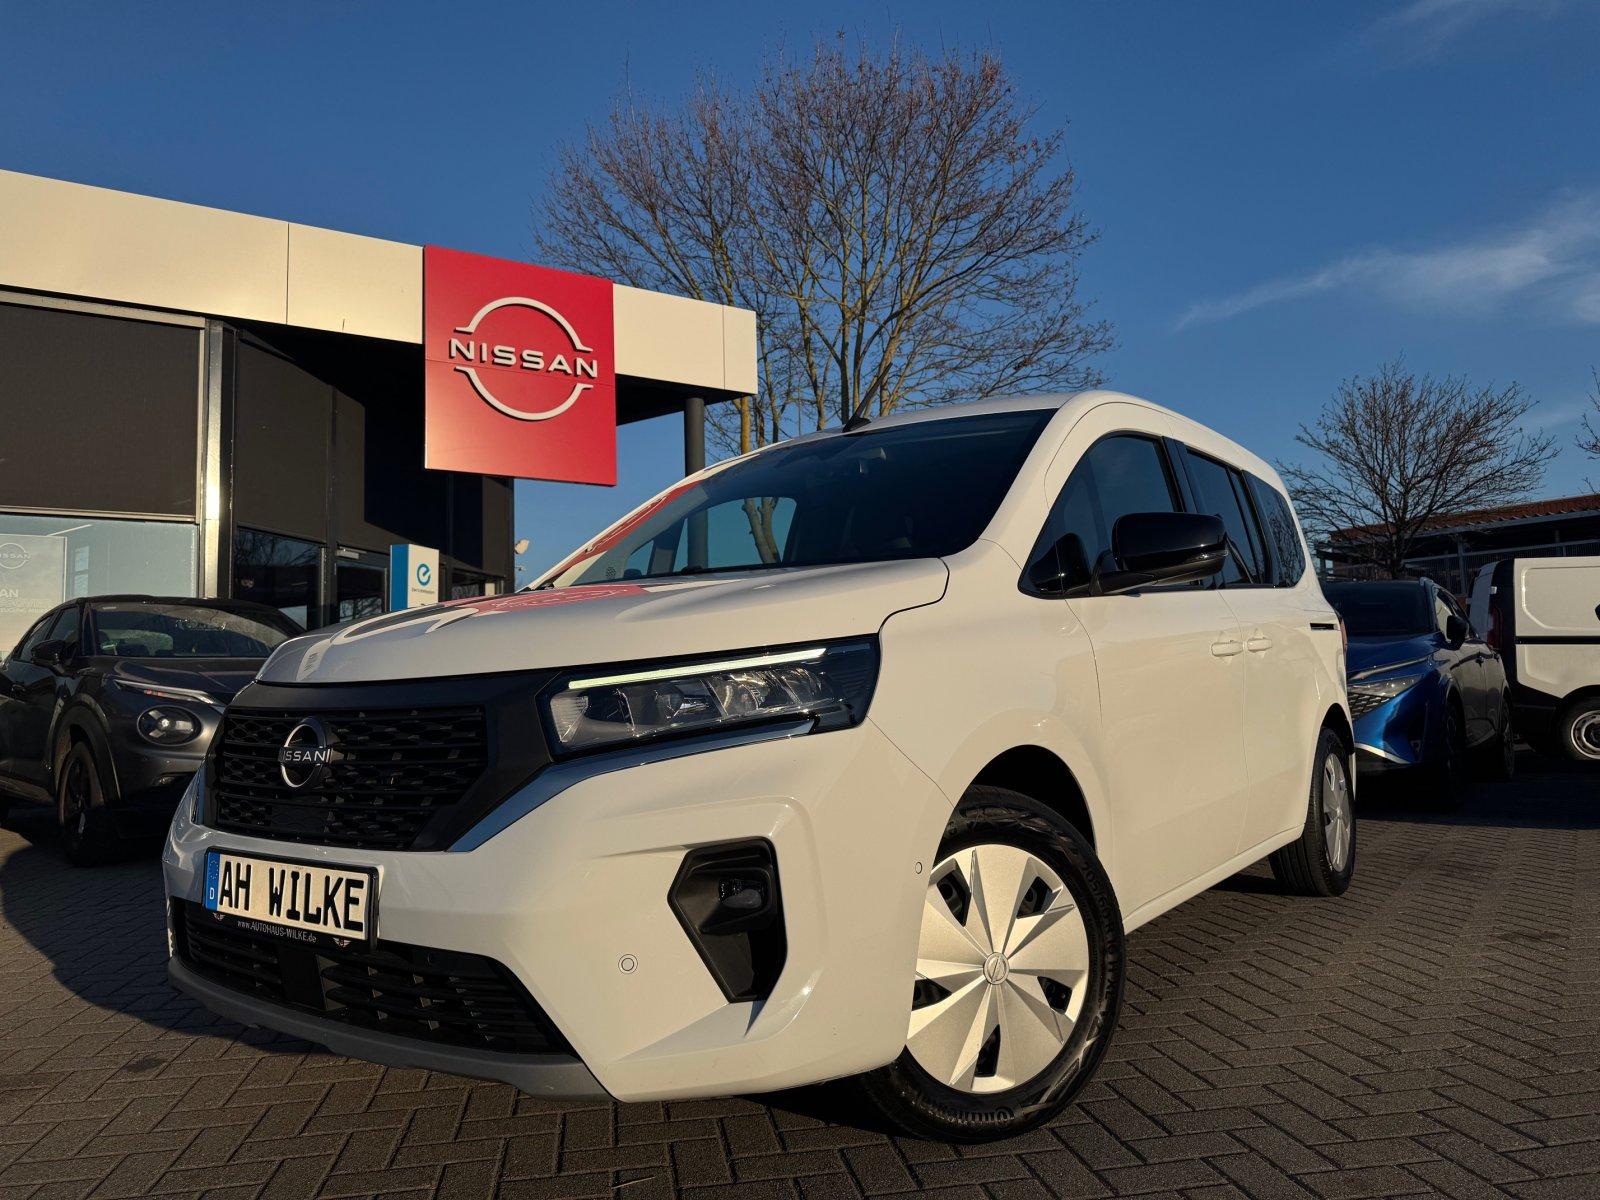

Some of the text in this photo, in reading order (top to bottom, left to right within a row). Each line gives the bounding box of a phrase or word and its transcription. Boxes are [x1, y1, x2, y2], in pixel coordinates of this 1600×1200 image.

[449, 338, 598, 378] NISSAN
[209, 887, 215, 900] D
[219, 860, 365, 932] AH WILKE
